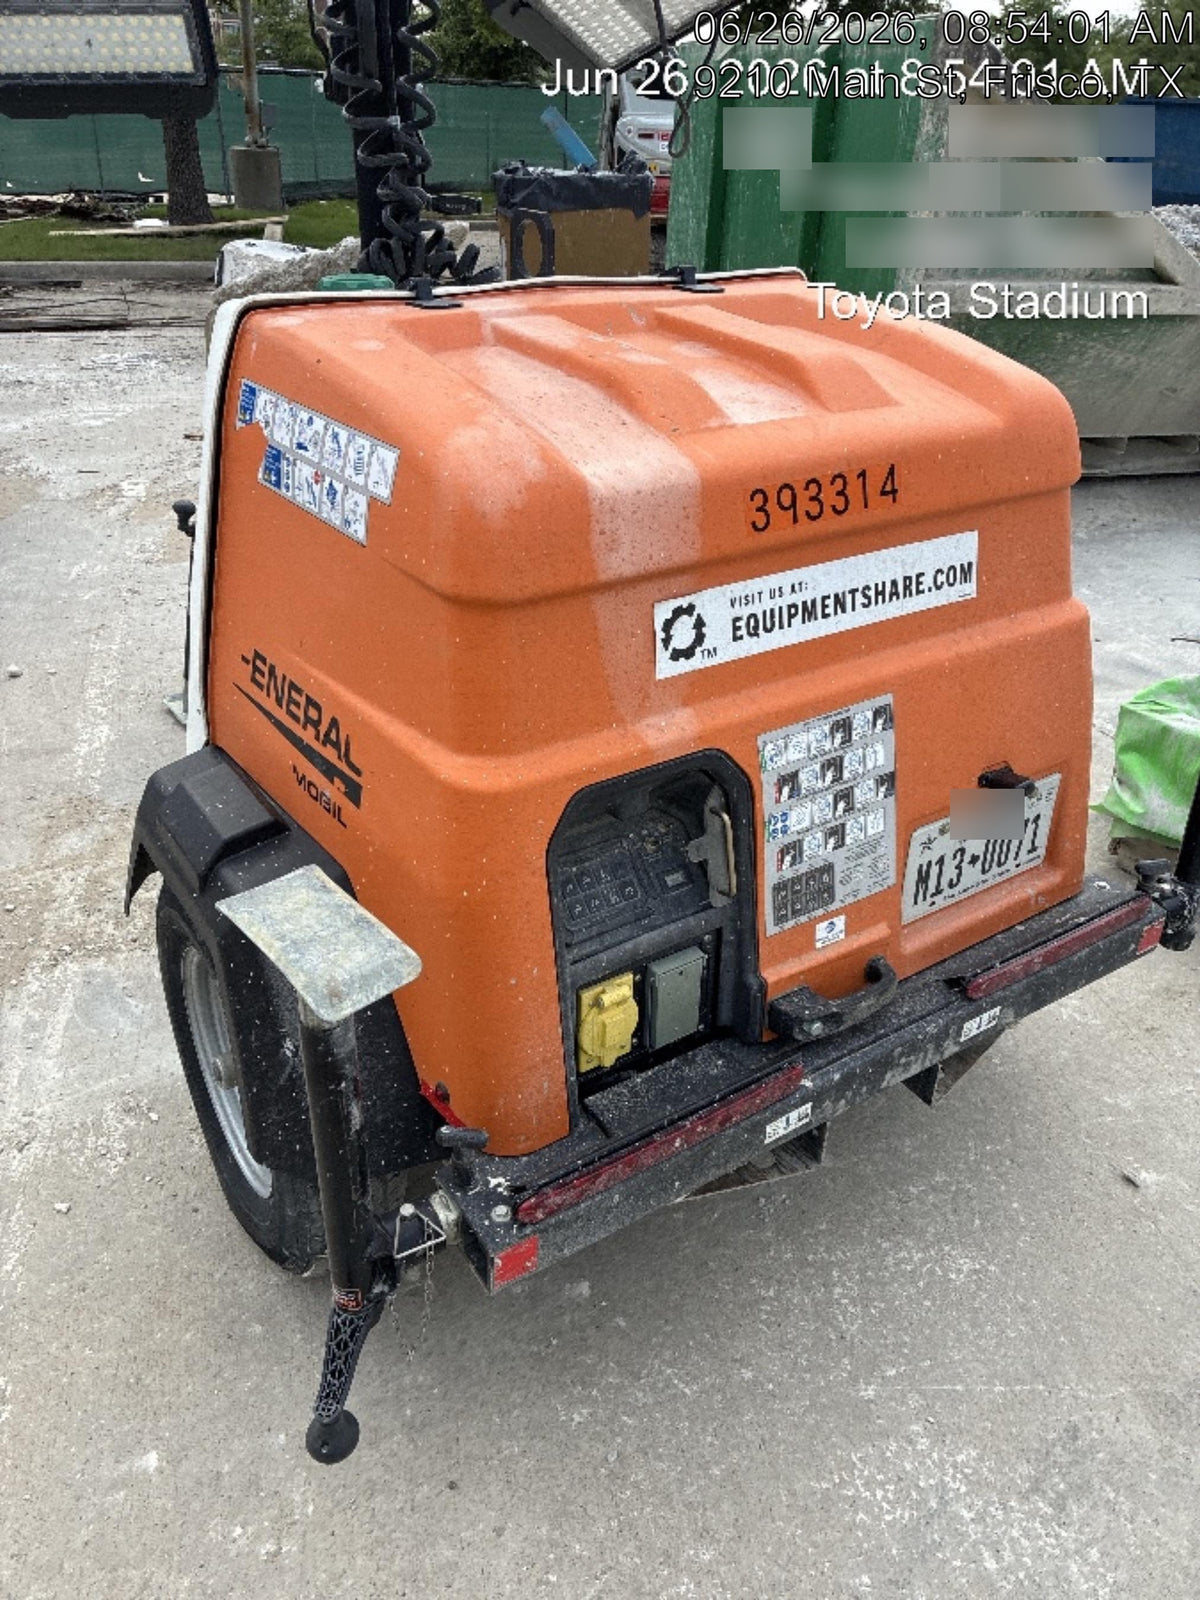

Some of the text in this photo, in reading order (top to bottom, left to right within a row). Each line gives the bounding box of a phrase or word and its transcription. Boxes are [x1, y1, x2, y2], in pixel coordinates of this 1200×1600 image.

[749, 463, 899, 533] 393314
[730, 581, 808, 608] VISIT US AT:
[731, 561, 974, 643] EQUIPMENTSHARE.COM
